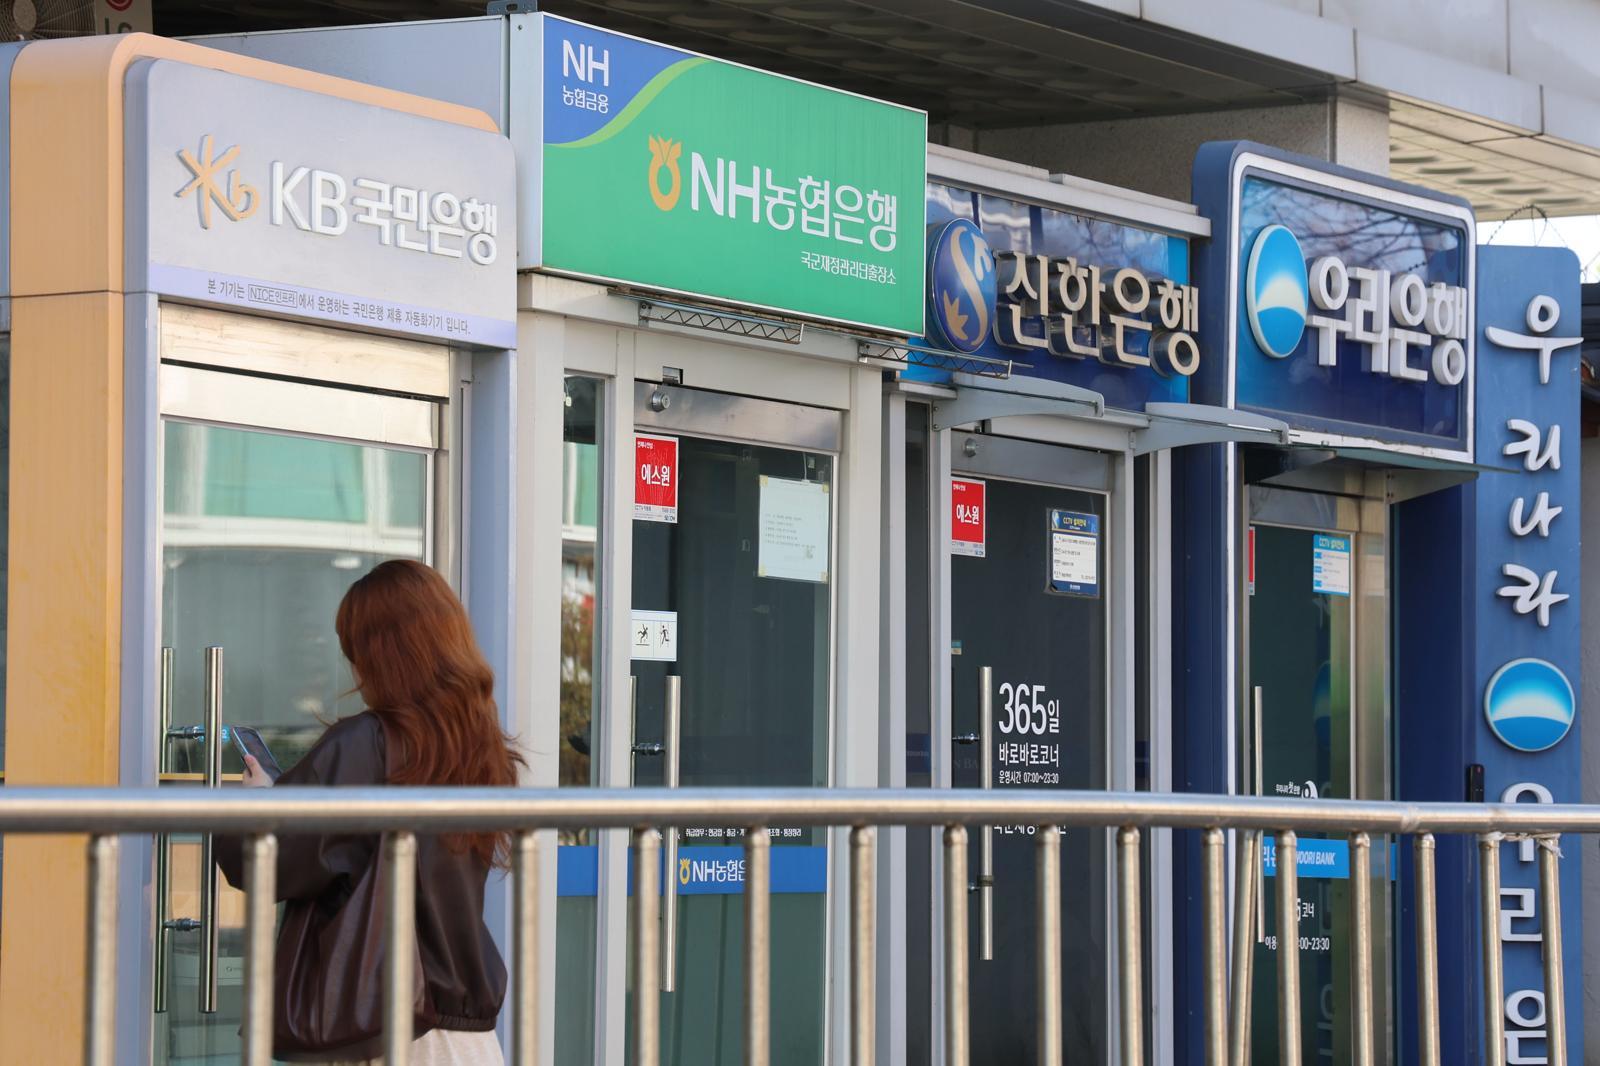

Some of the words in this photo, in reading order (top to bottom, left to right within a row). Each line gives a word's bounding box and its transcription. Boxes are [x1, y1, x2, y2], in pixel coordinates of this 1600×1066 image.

[562, 39, 609, 87] NH
[562, 86, 609, 114] 농협금융
[271, 160, 498, 266] KB국민은행
[690, 151, 897, 252] NH농협은행
[207, 278, 217, 295] 본
[219, 280, 246, 299] 기기는
[317, 295, 350, 317] 운영하는
[351, 301, 385, 322] 국민은행
[386, 307, 403, 323] 제휴
[404, 310, 444, 330] 자동화기기
[1004, 252, 1200, 377] 신한은행
[1307, 255, 1468, 387] 우리은행
[640, 463, 671, 487] 에스원
[956, 503, 980, 525] 에스원
[998, 741, 1060, 767] 바로바로코너
[998, 770, 1022, 784] 운영시간
[692, 859, 745, 883] NH농협
[1315, 851, 1336, 866] BANK
